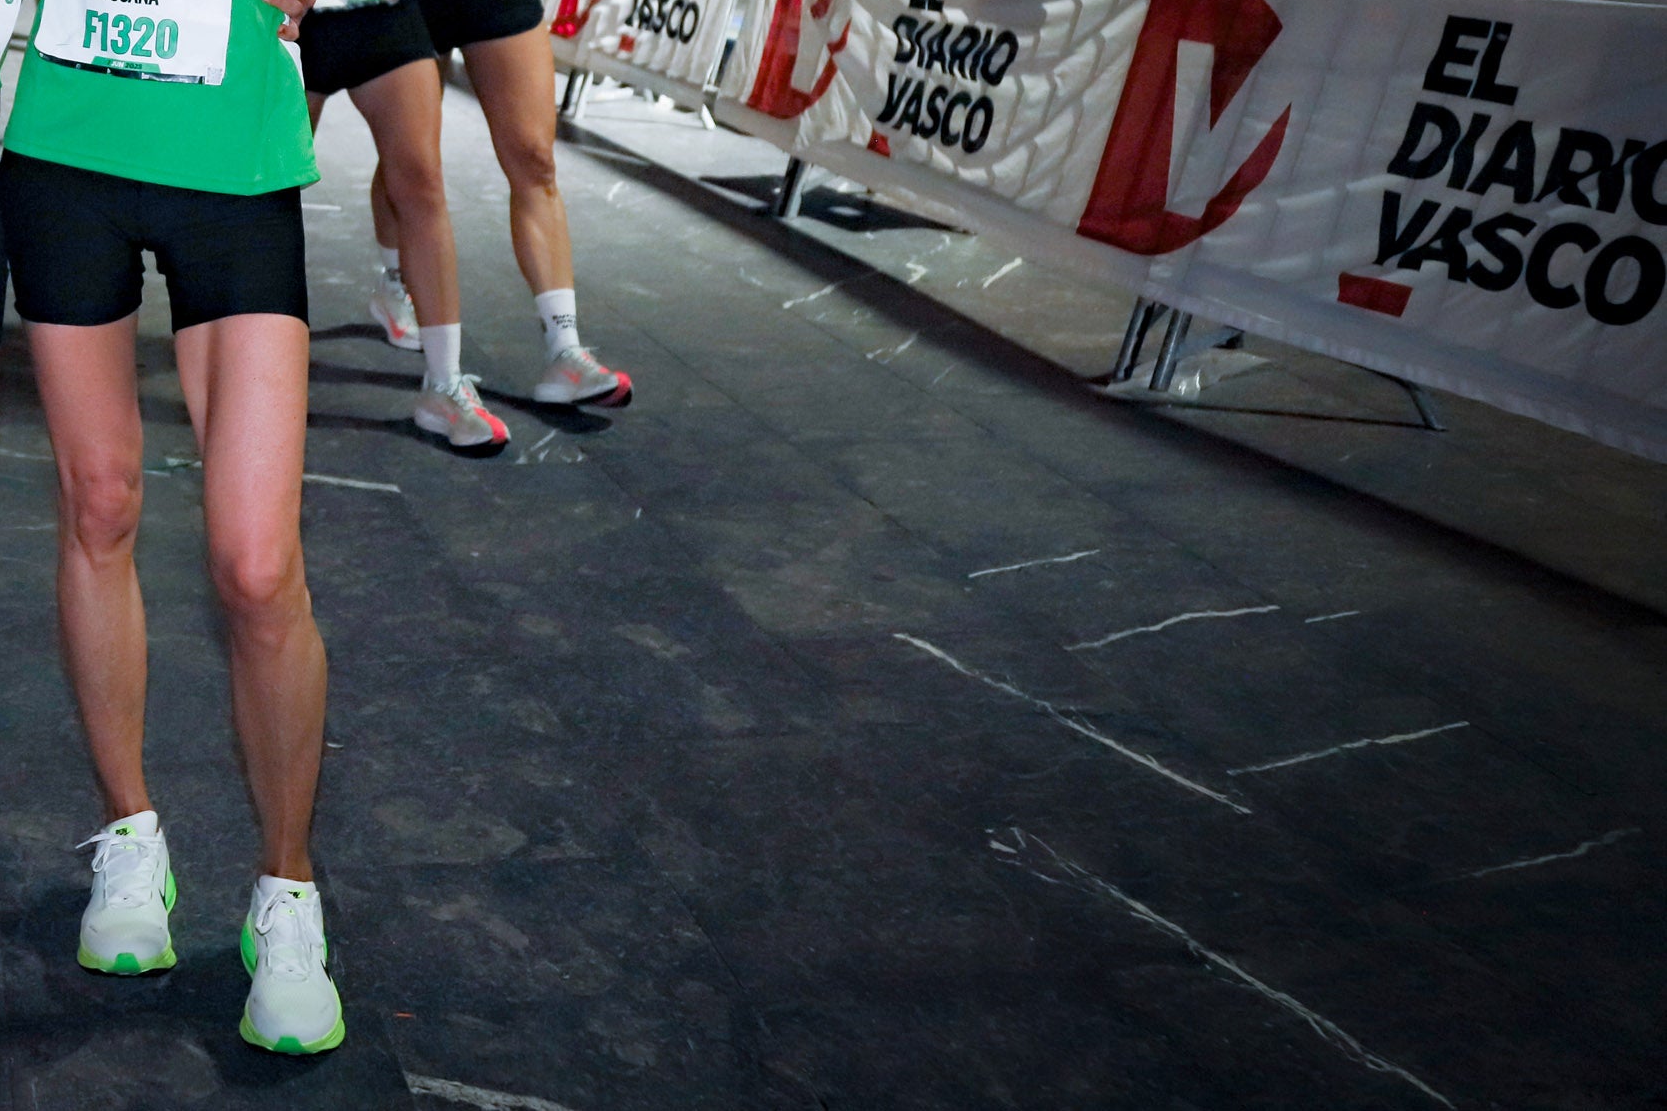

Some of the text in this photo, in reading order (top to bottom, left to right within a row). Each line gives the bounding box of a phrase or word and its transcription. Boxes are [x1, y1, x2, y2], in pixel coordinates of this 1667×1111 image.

[83, 9, 179, 59] F1320
[111, 60, 124, 68] JUN
[893, 14, 1019, 86] DIARIO
[1423, 15, 1519, 106] EL
[876, 73, 995, 154] VASCO
[1373, 192, 1666, 326] VASCO
